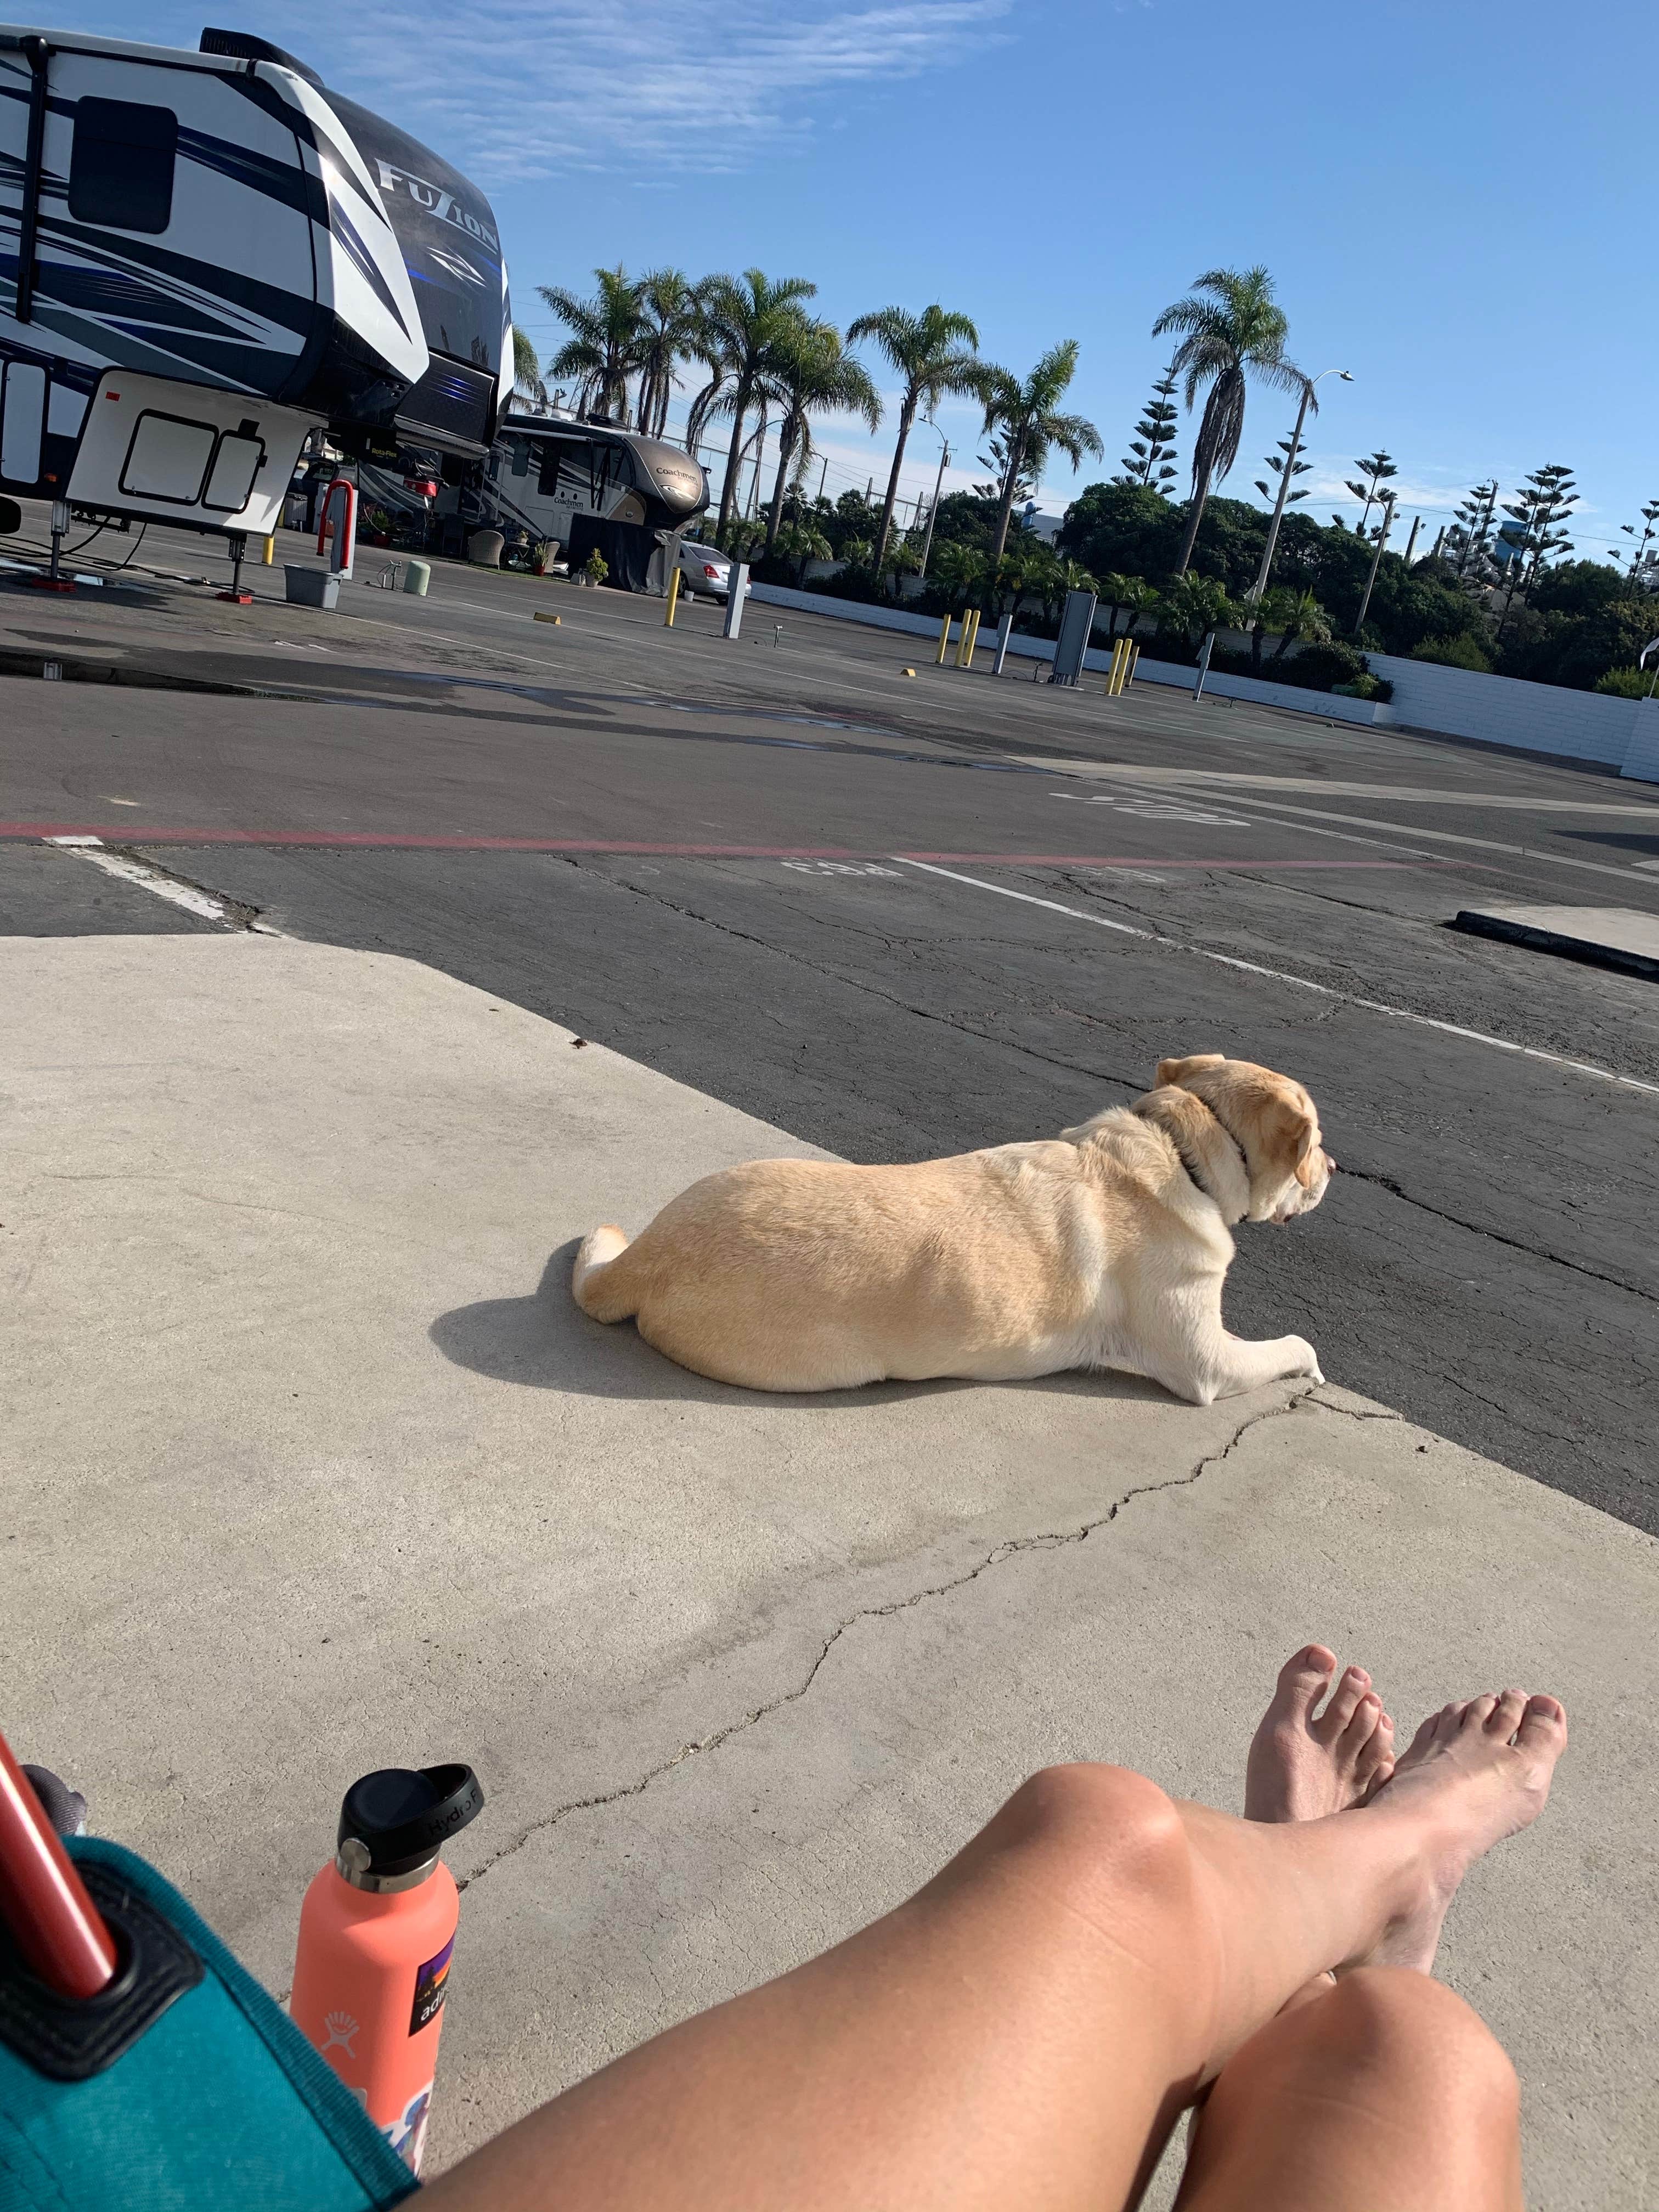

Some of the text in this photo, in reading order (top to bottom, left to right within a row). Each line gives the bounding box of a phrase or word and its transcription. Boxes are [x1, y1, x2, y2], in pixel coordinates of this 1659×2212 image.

[371, 447, 398, 458] Rota-Flex
[656, 467, 698, 483] Coachmen
[554, 496, 584, 507] Coachmen
[1047, 793, 1252, 827] STOP
[430, 1799, 471, 1835] Hydro
